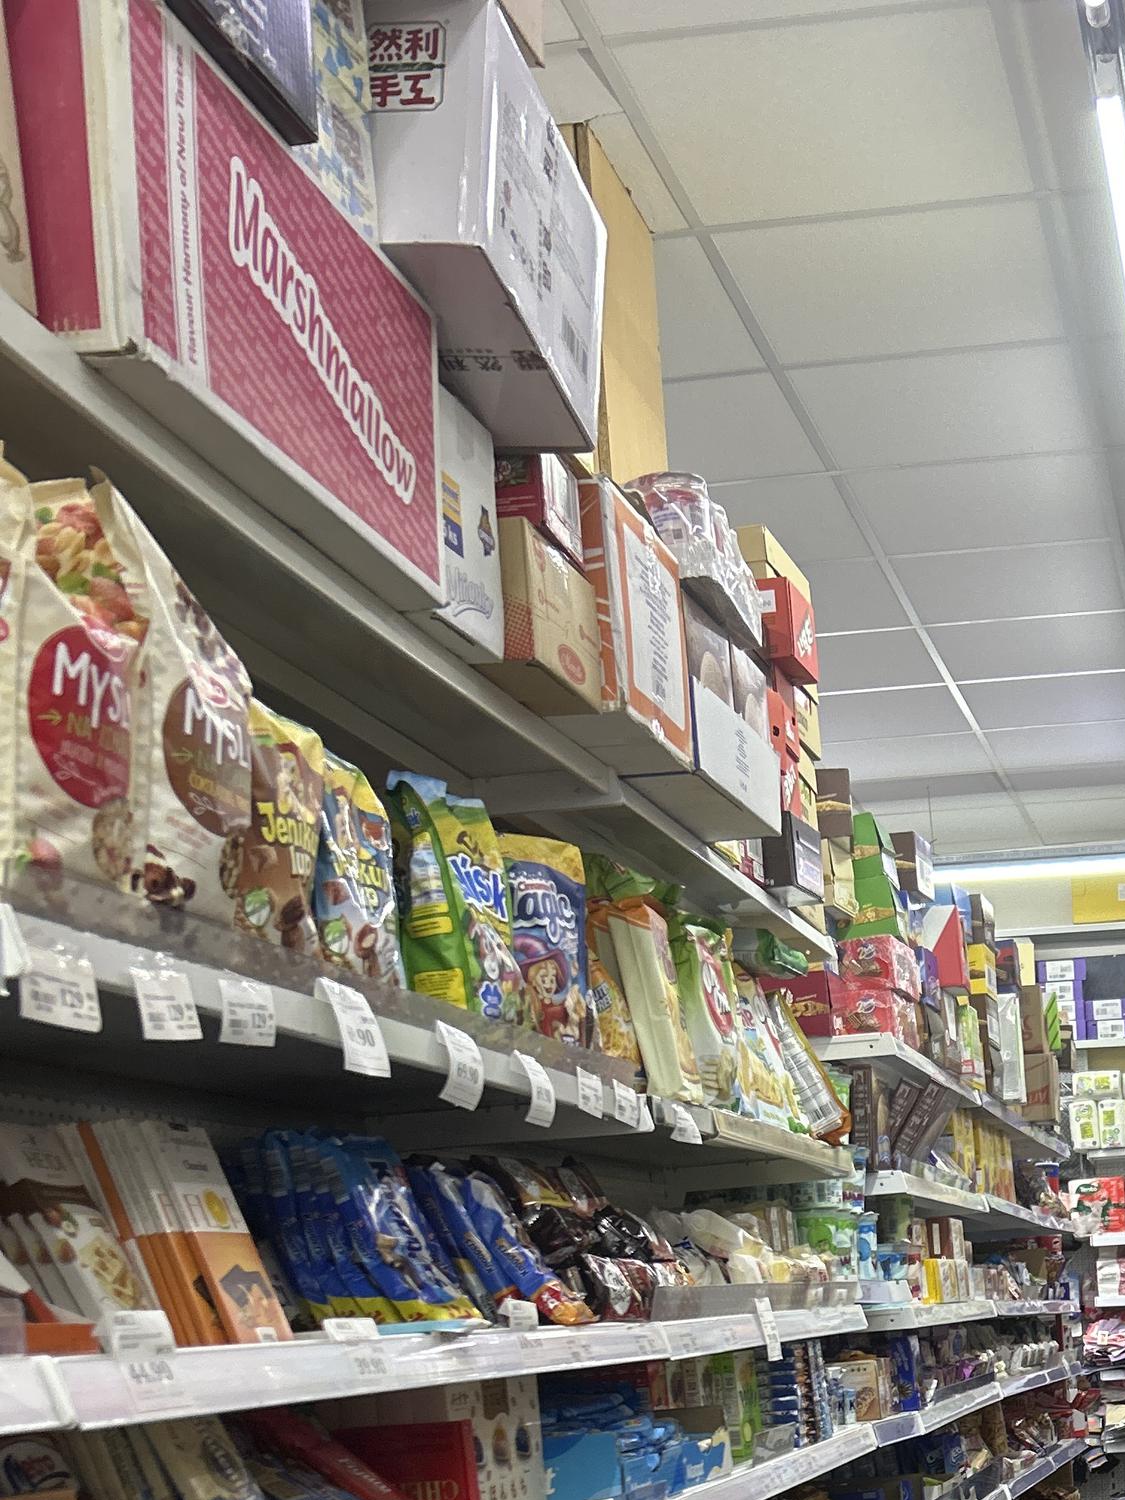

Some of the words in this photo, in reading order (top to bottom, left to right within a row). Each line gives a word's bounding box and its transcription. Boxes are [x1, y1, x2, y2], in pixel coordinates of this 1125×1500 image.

[174, 44, 184, 111] Tastes
[368, 27, 440, 62] 然利
[368, 73, 436, 108] 手工
[175, 114, 185, 161] New
[179, 192, 193, 287] Harmony
[186, 290, 199, 366] Flavour
[230, 157, 419, 503] Marshmallow
